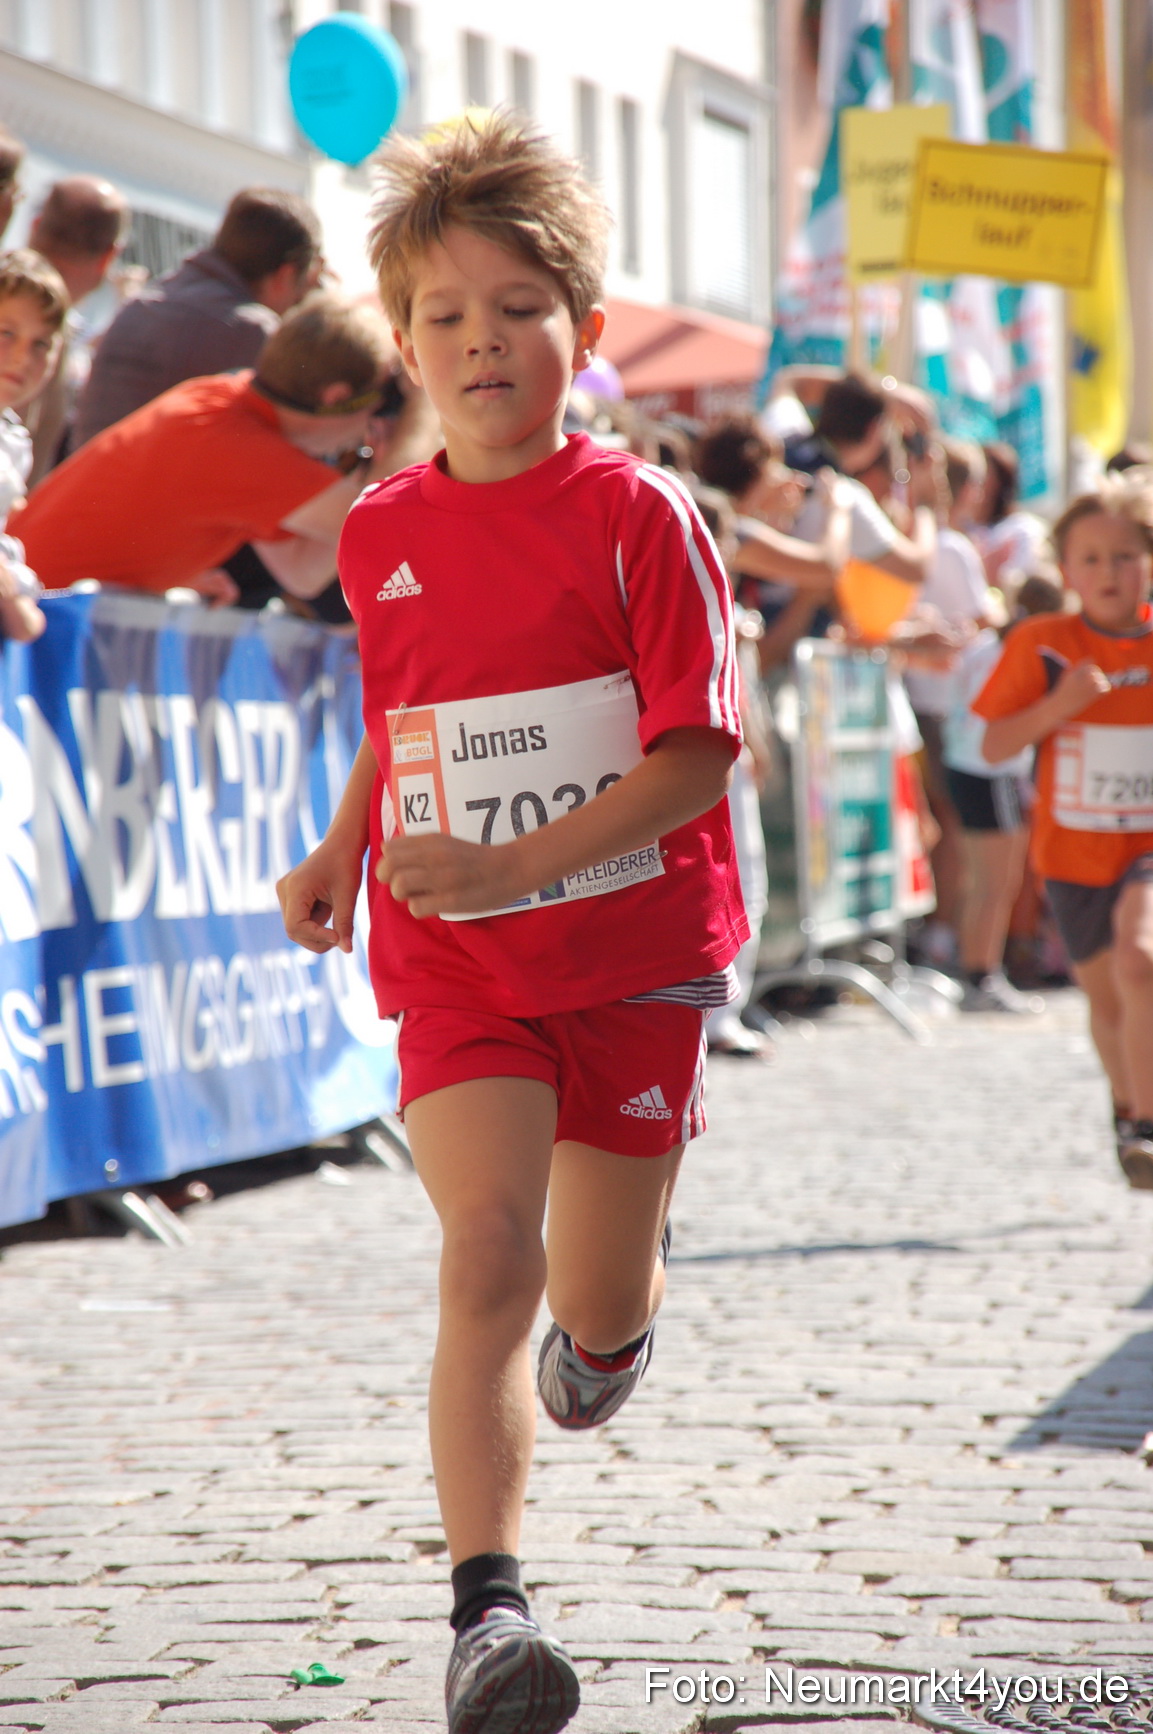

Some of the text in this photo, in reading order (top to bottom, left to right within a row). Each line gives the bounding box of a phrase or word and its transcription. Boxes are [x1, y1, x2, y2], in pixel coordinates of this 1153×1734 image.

[376, 583, 423, 602] adidas
[452, 722, 548, 763] Jonas
[1092, 770, 1153, 802] 720
[403, 792, 432, 824] K2
[567, 847, 657, 886] PFLEIDERER
[569, 863, 659, 896] AKTIENGESELLSCHAFT
[619, 1103, 673, 1120] adidas
